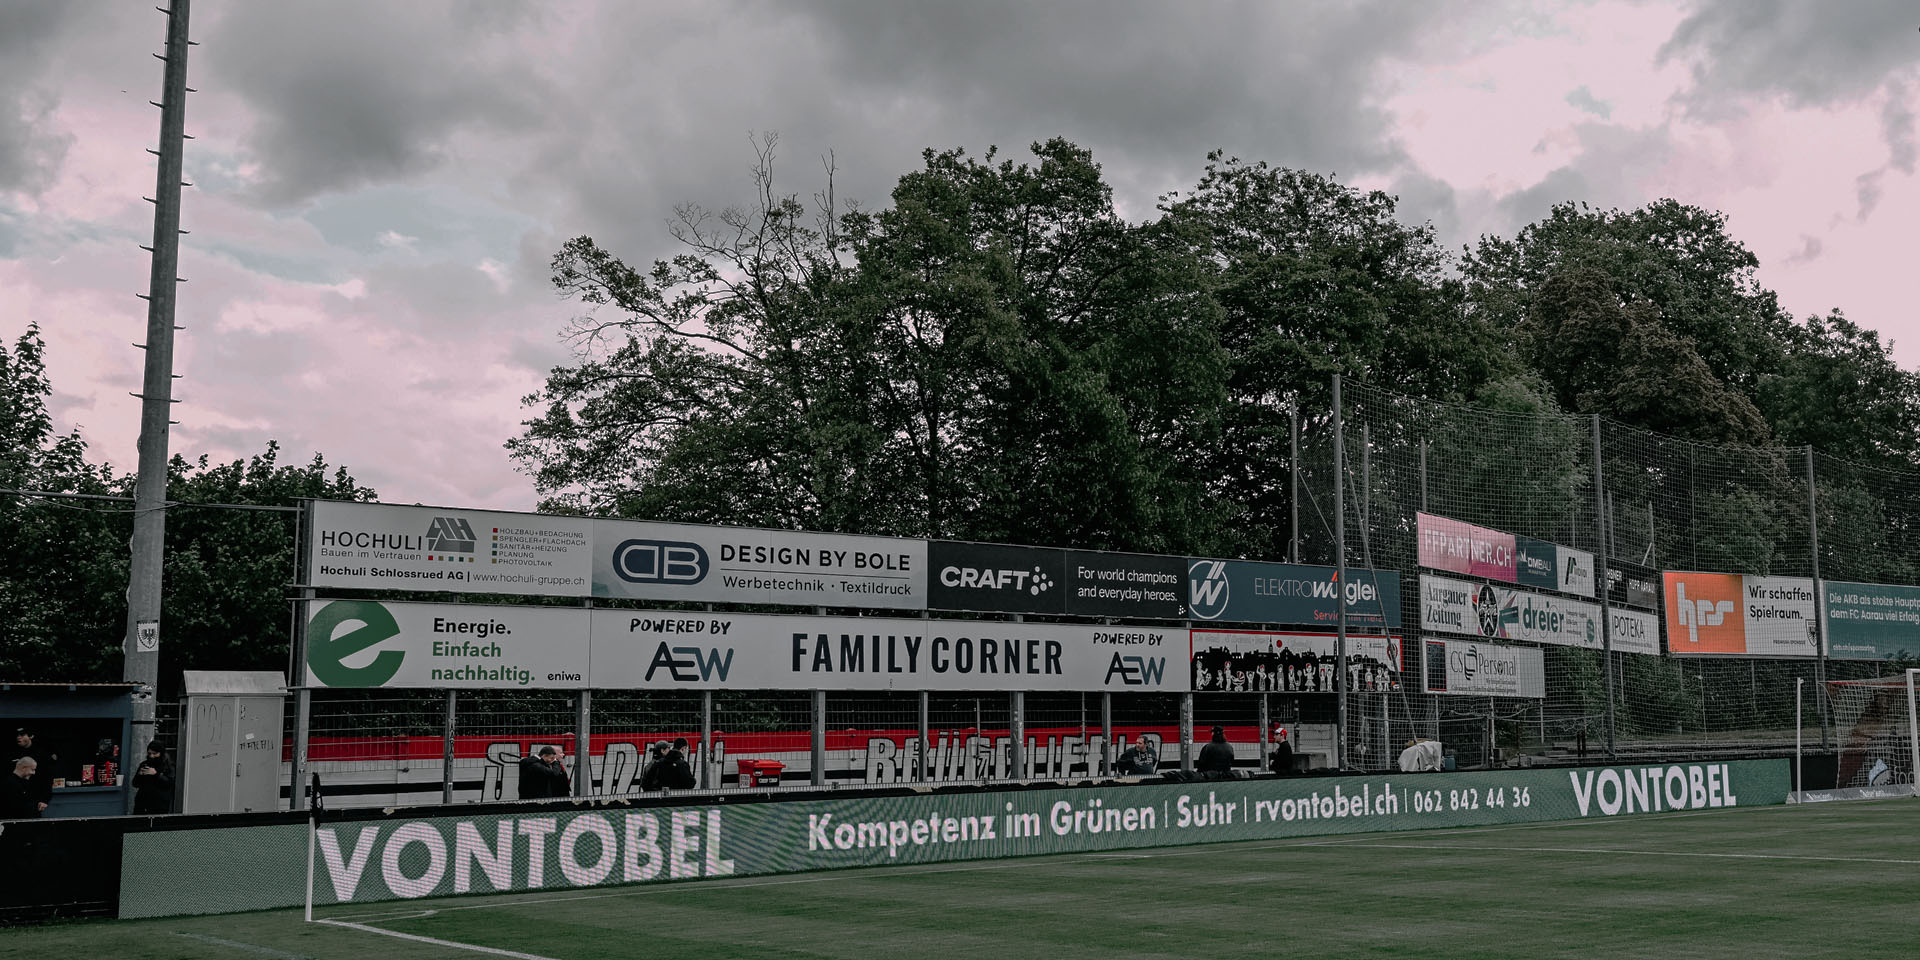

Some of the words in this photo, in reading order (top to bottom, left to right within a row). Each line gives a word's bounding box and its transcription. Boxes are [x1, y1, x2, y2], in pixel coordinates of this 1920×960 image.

[321, 530, 422, 550] HOCHULI
[1424, 529, 1513, 569] FFPARTNER.CH
[320, 547, 351, 557] Bauen
[356, 549, 369, 558] im
[374, 551, 422, 561] Vertrauen
[498, 559, 553, 567] PHOTOVOLTAIK
[720, 544, 811, 566] DESIGN
[819, 551, 847, 567] BY
[854, 552, 911, 571] BOLE
[319, 565, 367, 577] Hochuli
[370, 567, 443, 580] Schlossrued
[447, 571, 464, 580] AG
[472, 573, 585, 586] www.hochuli-gruppe.ch
[723, 575, 825, 591] Werbetechnik
[840, 581, 912, 595] Textildruck
[940, 566, 1029, 591] CRAFT
[1078, 566, 1095, 579] For
[1098, 568, 1124, 580] world
[1127, 570, 1178, 585] champions
[1078, 586, 1097, 598] and
[1099, 588, 1141, 602] everyday
[1144, 591, 1177, 602] heroes.
[1254, 570, 1377, 606] ELEKTROwügler
[1425, 583, 1469, 609] Aargauer
[1749, 586, 1767, 600] Wir
[1770, 587, 1812, 602] schaffen
[1829, 593, 1842, 604] Die
[1843, 594, 1858, 605] AKB
[1860, 595, 1871, 605] als
[1872, 596, 1893, 606] stolze
[1425, 603, 1463, 629] Zeitung
[1522, 597, 1565, 633] dreier
[1676, 582, 1734, 642] hrs
[1750, 605, 1803, 622] Spielraum.
[1831, 611, 1848, 620] dem
[1849, 612, 1860, 620] FC
[1861, 612, 1884, 621] Aarau
[1885, 612, 1898, 621] viel
[432, 617, 512, 637] Energie.
[630, 617, 705, 633] POWERED
[709, 619, 731, 635] BY
[1611, 614, 1646, 641] POTEKA
[431, 640, 502, 658] Einfach
[1093, 632, 1144, 645] POWERED
[1148, 633, 1164, 646] BY
[644, 640, 734, 682] AEW
[791, 632, 922, 674] FAMILY
[931, 636, 1063, 675] CORNER
[1478, 651, 1516, 677] Personal
[430, 664, 537, 685] nachhaltig.
[547, 671, 581, 682] eniwa
[1104, 651, 1166, 685] AEW
[317, 809, 735, 900] VONTOBEL
[808, 813, 996, 858] Kompetenz
[1005, 802, 1041, 838] im
[1050, 799, 1156, 837] Grünen
[1176, 792, 1236, 828] Suhr
[1255, 782, 1398, 822] rvontobel.ch
[1413, 790, 1443, 812] 062
[1449, 788, 1478, 810] 842
[1486, 787, 1504, 809] 44
[1512, 786, 1530, 808] 36
[1569, 764, 1737, 817] VONTOBEL
